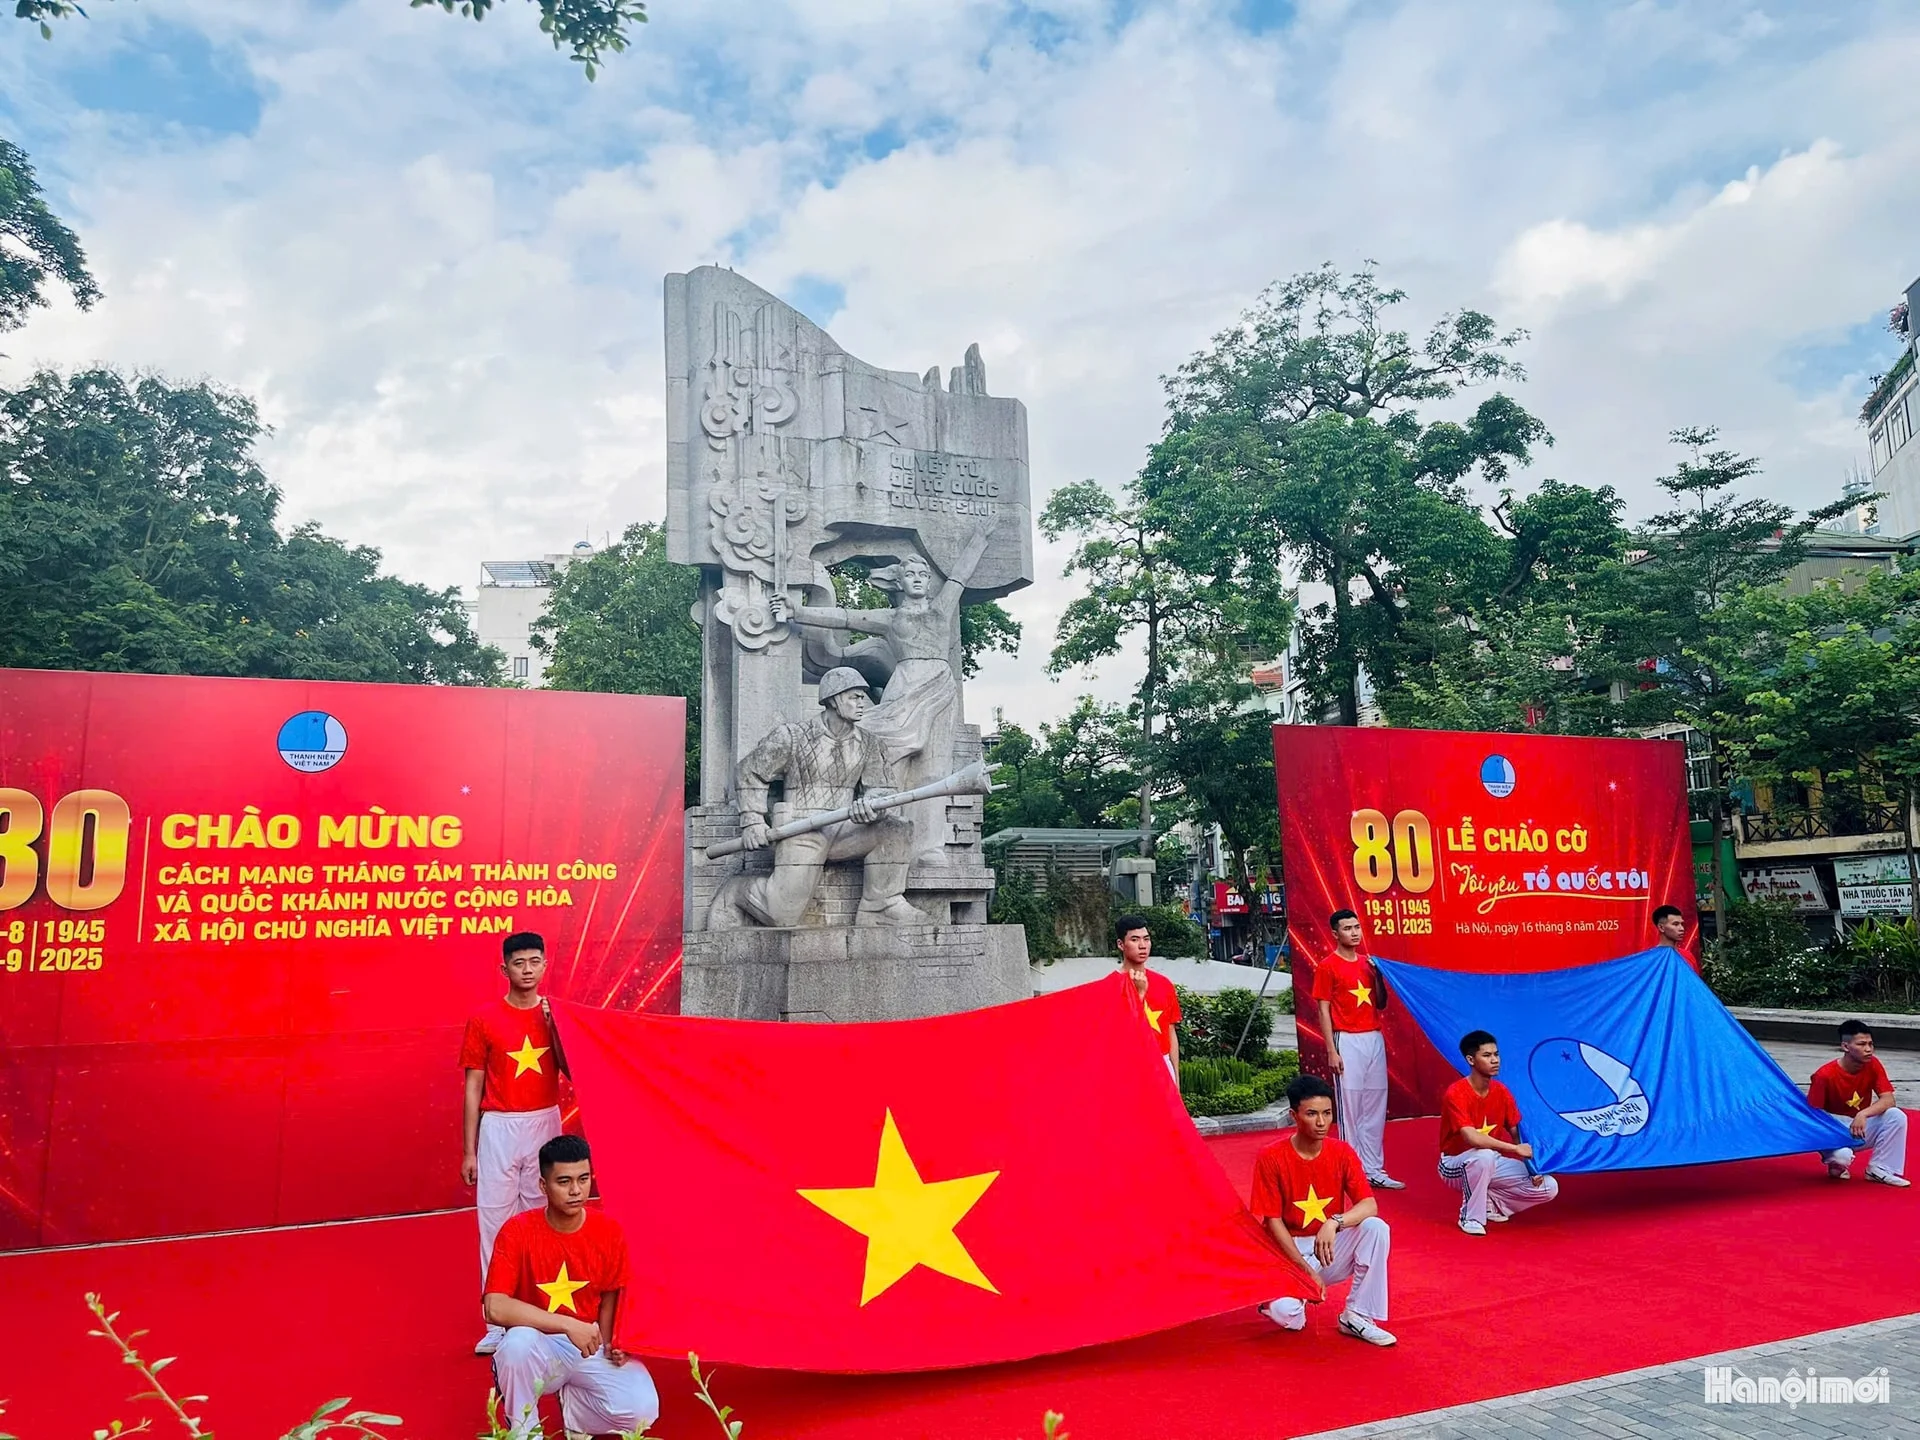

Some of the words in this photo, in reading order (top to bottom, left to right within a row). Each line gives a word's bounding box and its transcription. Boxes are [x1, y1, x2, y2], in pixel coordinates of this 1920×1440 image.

[161, 805, 302, 849] CHÀO
[317, 805, 463, 848] MỪNG
[1446, 816, 1476, 852] LỄ
[1483, 822, 1548, 853] CHÀO
[1555, 823, 1588, 853] CỜ
[1350, 808, 1435, 894] 80
[158, 861, 230, 885] CÁCH
[239, 865, 314, 889] MẠNG
[322, 861, 405, 884] THÁNG
[413, 859, 462, 882] TÁM
[470, 859, 549, 881] THÀNH
[556, 859, 617, 881] CÔNG
[1450, 862, 1487, 895] Tôi
[1477, 876, 1520, 914] yêu
[1523, 865, 1550, 891] TỔ
[1556, 865, 1611, 891] QUỐC
[1616, 868, 1649, 890] TÔI
[156, 889, 192, 914] VÀ
[200, 885, 273, 915] QUỐC
[281, 888, 368, 912] KHÁNH
[376, 886, 447, 909] NƯỚC
[454, 885, 518, 912] CỘNG
[526, 884, 573, 907] HÒA
[1364, 899, 1393, 916] 19-8
[1400, 899, 1430, 915] 1945
[1842, 888, 1859, 900] NHÀ
[1888, 887, 1905, 898] TÂN
[43, 920, 105, 943] 1945
[153, 918, 191, 942] XÃ
[200, 917, 245, 946] HỘI
[253, 915, 306, 940] CHỦ
[315, 915, 392, 938] NGHĨA
[400, 913, 453, 940] VIỆT
[460, 916, 513, 934] NAM
[1373, 918, 1395, 935] 2-9
[1402, 918, 1432, 935] 2025
[1456, 922, 1469, 934] Hà
[1472, 920, 1493, 935] Nội,
[1494, 923, 1519, 936] ngày
[1522, 921, 1532, 932] 16
[1535, 920, 1564, 936] tháng
[1566, 921, 1571, 931] 8
[1574, 920, 1594, 931] năm
[1597, 920, 1619, 931] 2025
[39, 948, 103, 972] 2025
